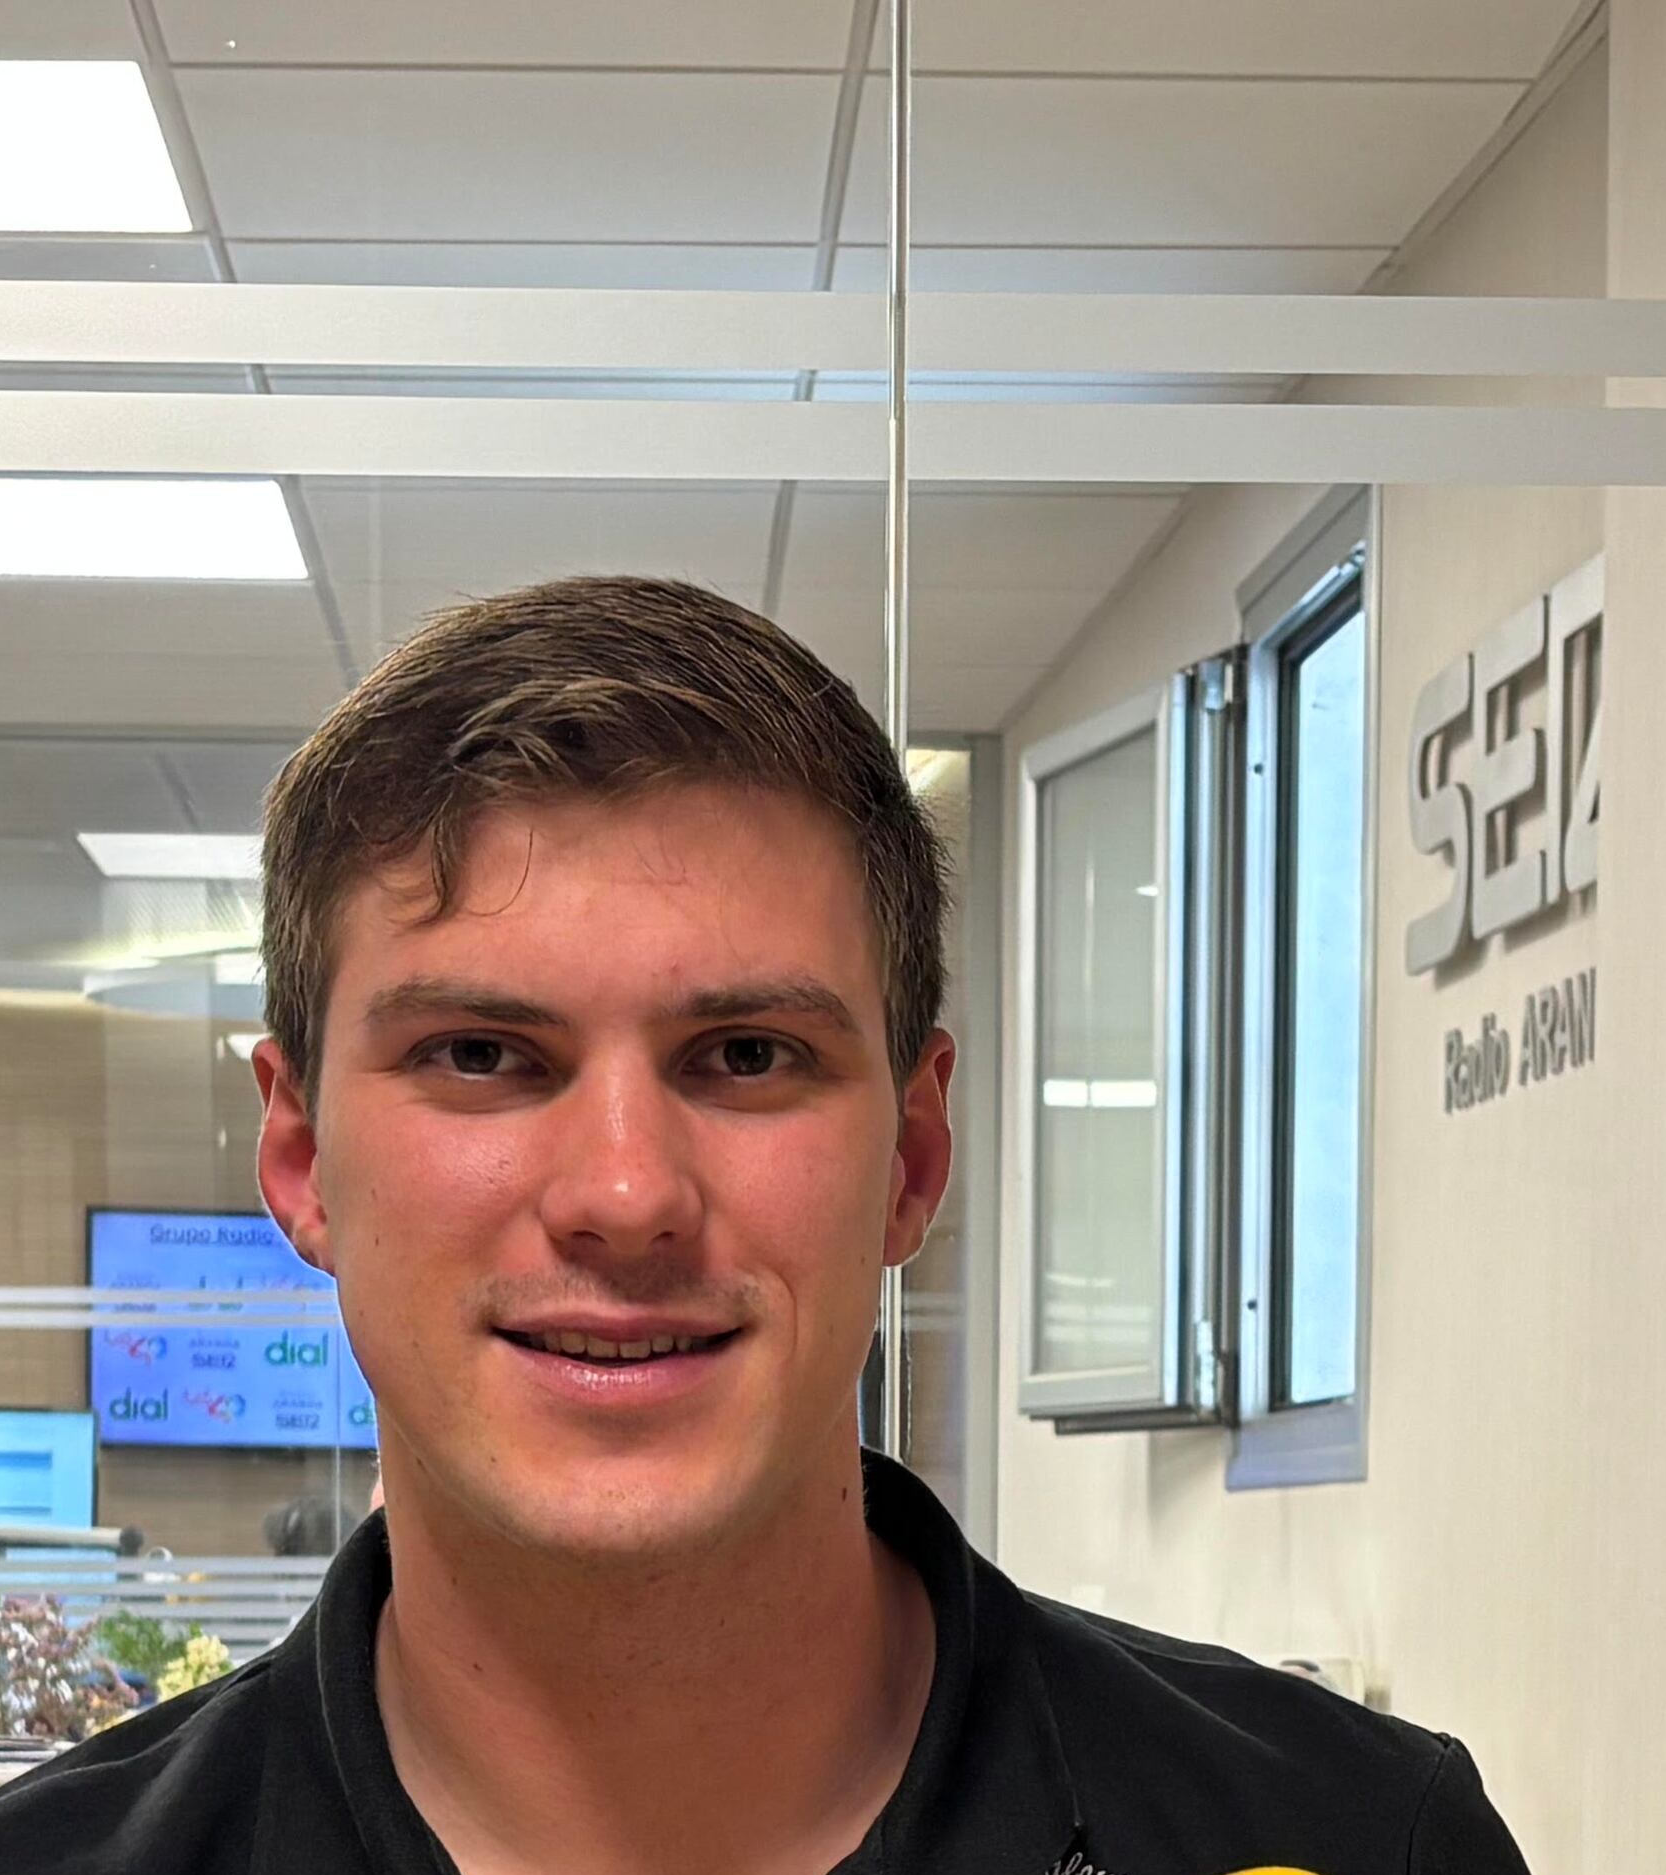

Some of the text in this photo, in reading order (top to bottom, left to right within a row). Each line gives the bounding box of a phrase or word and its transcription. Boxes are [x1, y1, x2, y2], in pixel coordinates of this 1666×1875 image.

[1445, 1012, 1511, 1115] Radio
[149, 1224, 211, 1246] Grupo
[265, 1330, 328, 1367] dial
[109, 1387, 169, 1421] dial
